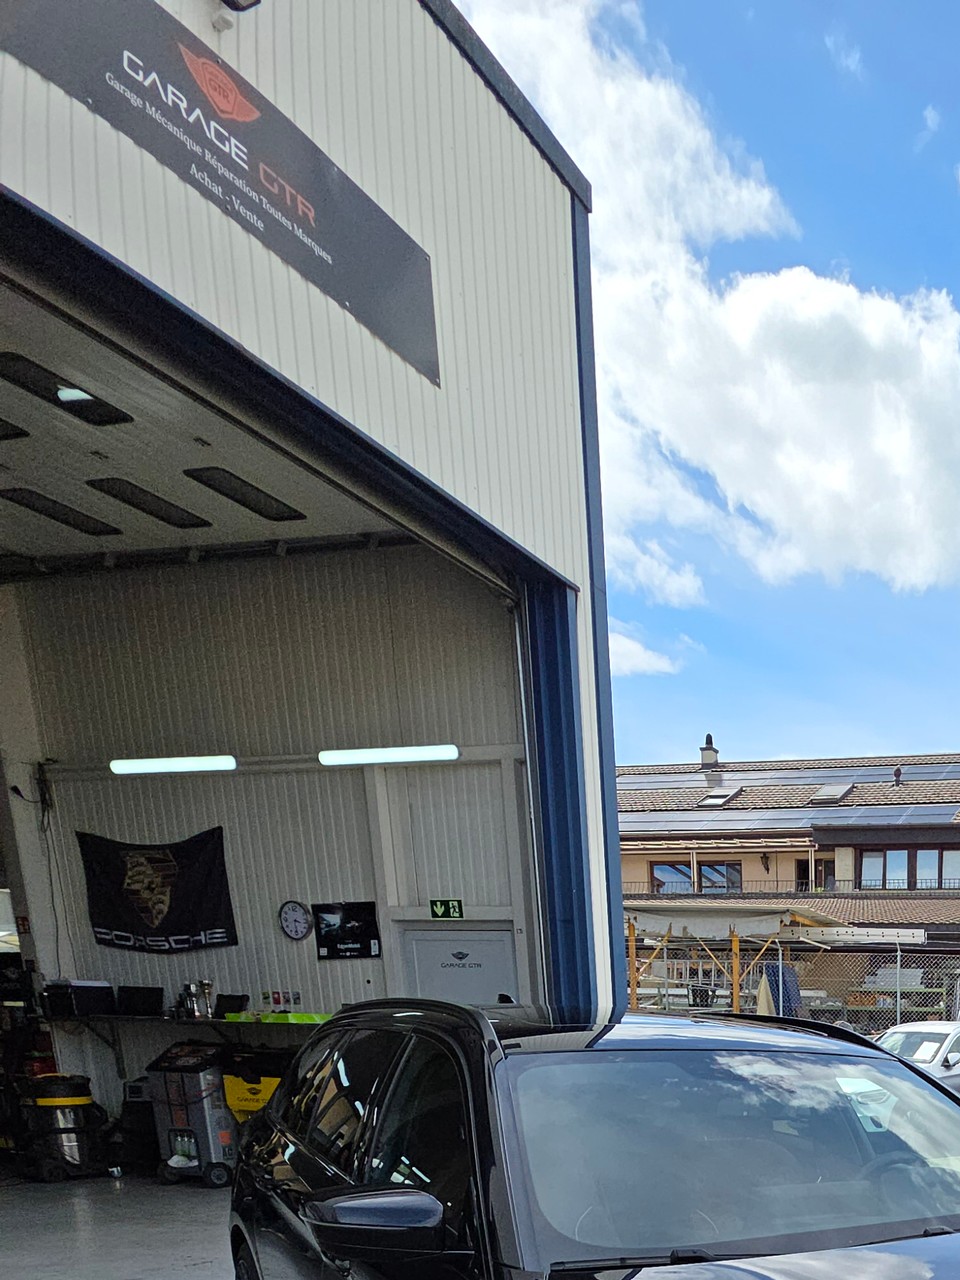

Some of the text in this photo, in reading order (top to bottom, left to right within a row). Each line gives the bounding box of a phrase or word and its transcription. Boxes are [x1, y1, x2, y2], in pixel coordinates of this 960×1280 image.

[105, 72, 333, 265] Garage Mécanique Réparation Toutes Marques
[122, 50, 316, 228] GARAGE GTR
[189, 163, 223, 199] Achat
[231, 194, 265, 232] Vente
[94, 927, 228, 950] PORSCHE
